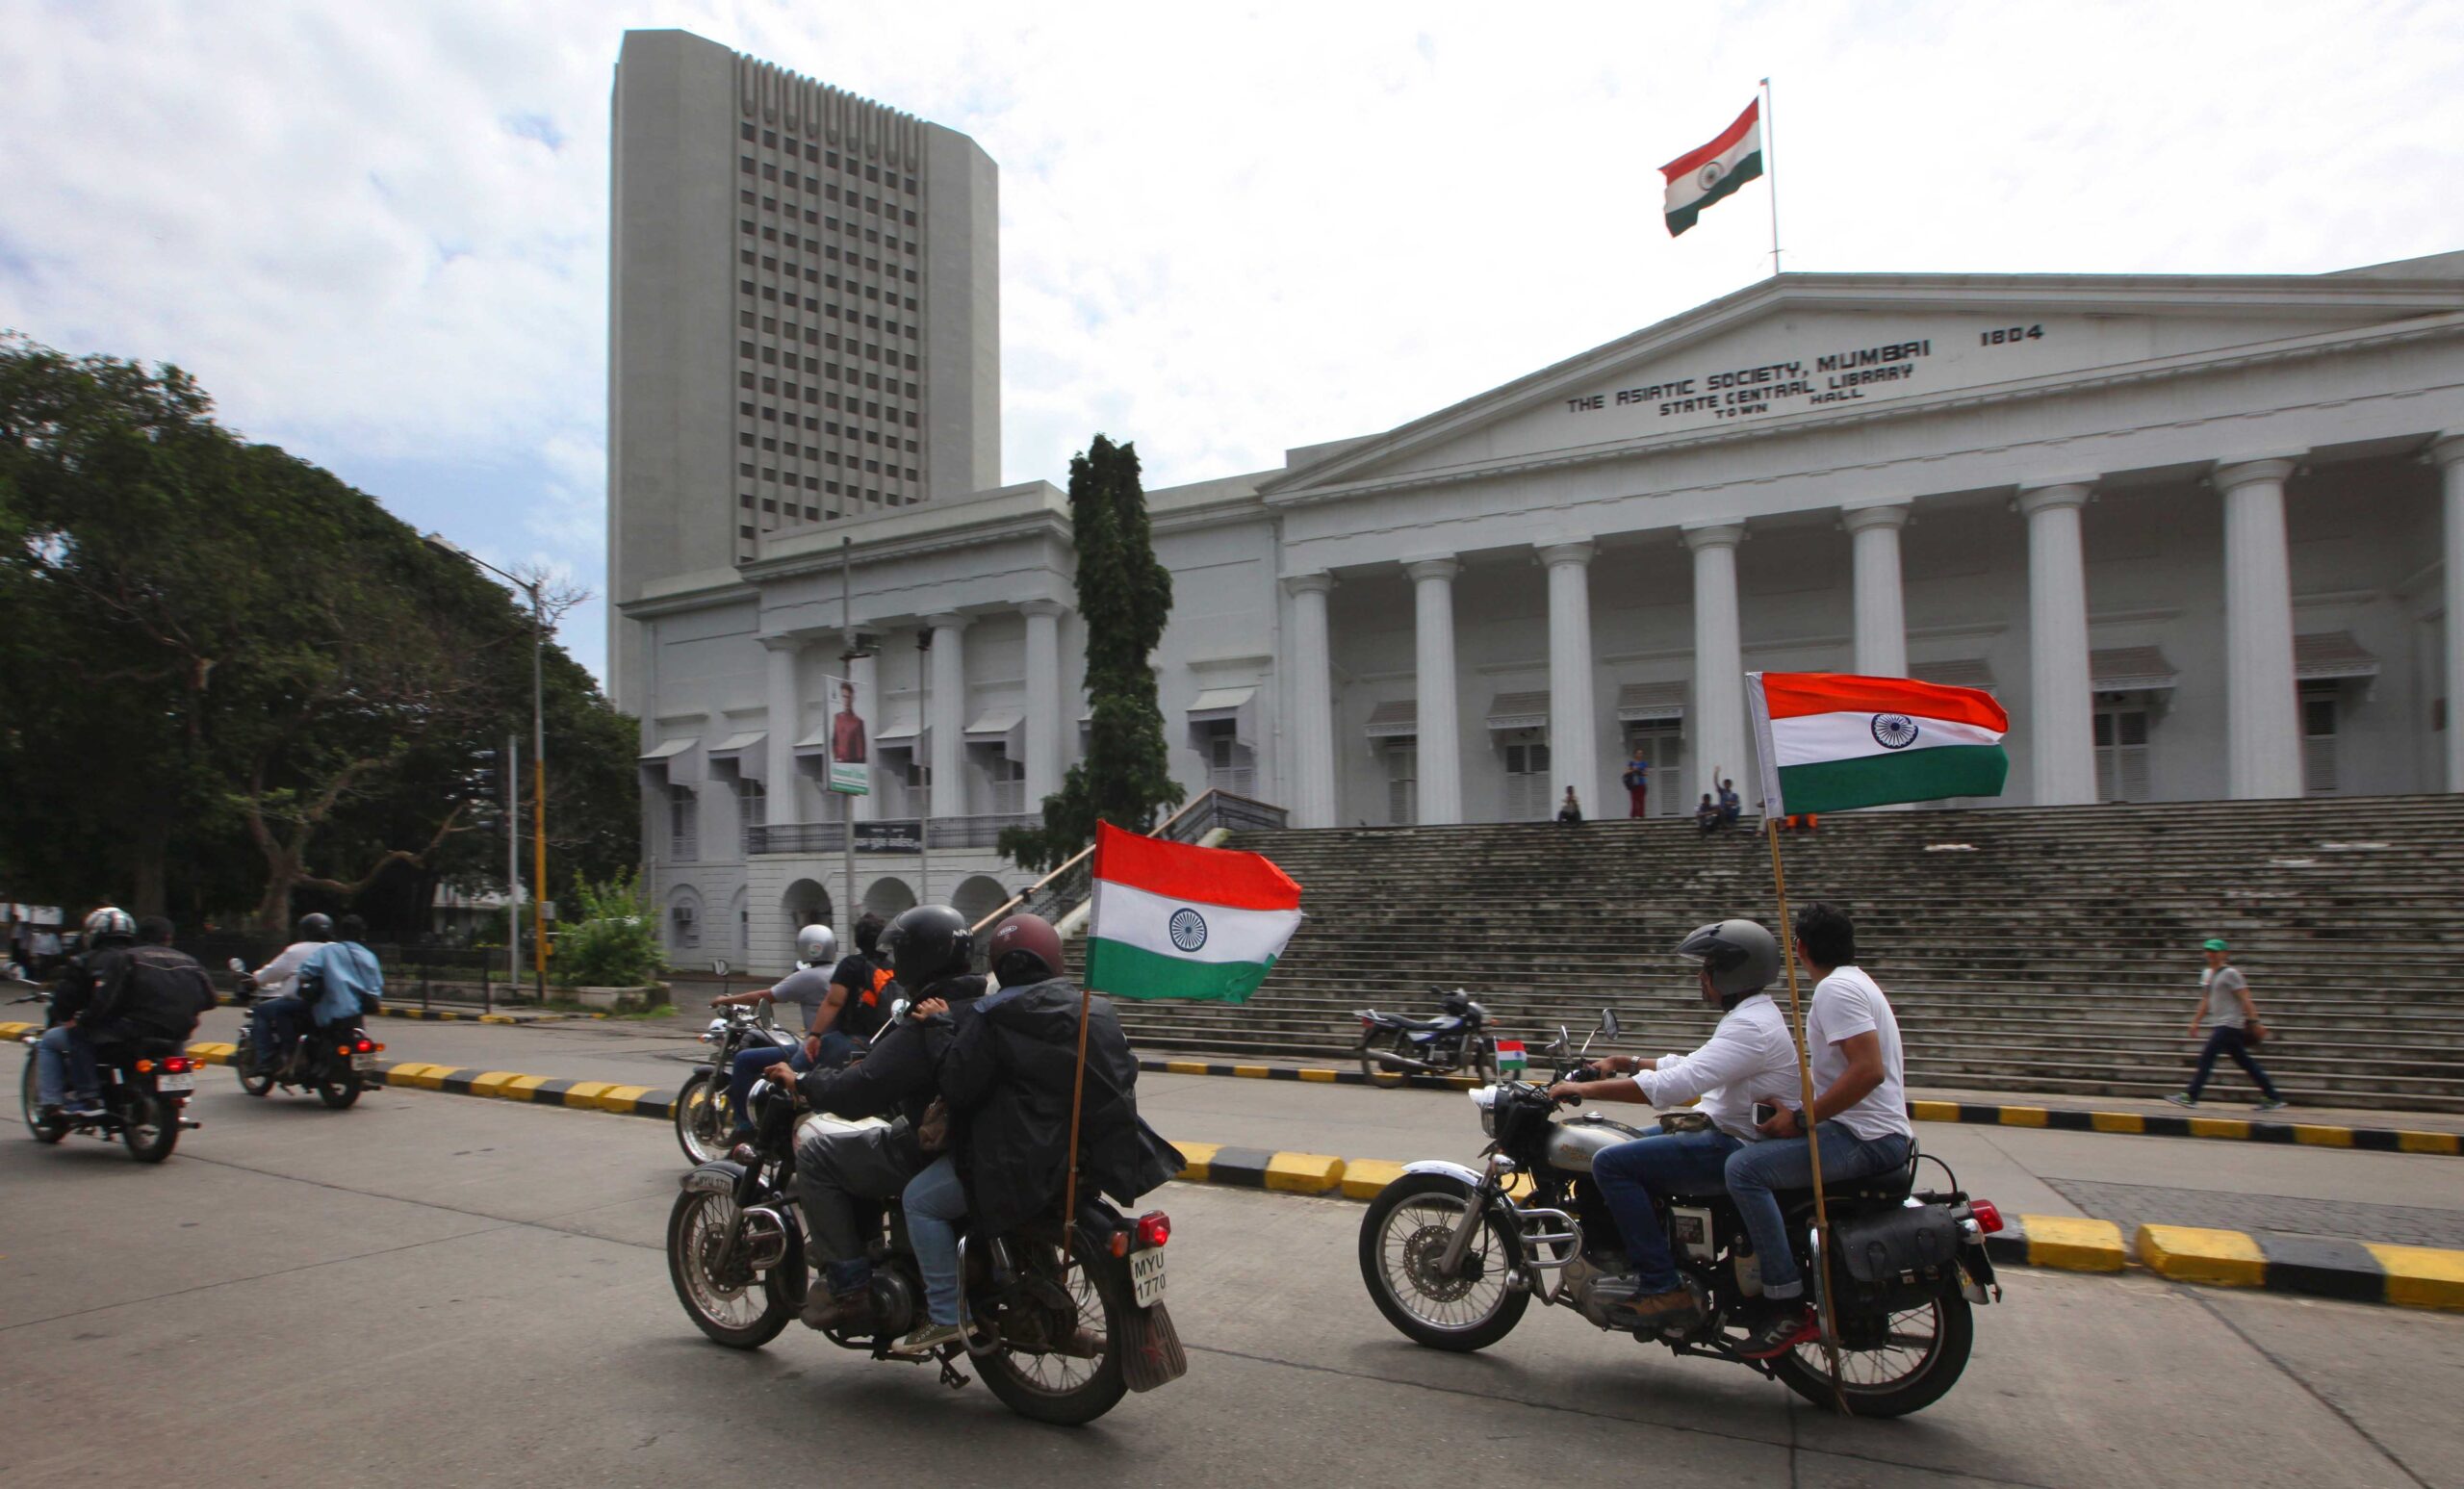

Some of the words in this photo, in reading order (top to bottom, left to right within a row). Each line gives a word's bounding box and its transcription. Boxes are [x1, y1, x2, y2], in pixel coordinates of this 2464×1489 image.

[1981, 323, 2044, 347] 1804
[1567, 395, 1604, 413] THE
[1616, 379, 1695, 406] ASIATIC
[1707, 361, 1810, 391] SOCIETY,
[1817, 339, 1931, 373] MUMBAI
[1659, 395, 1718, 416] STATE
[1726, 380, 1815, 404] CENTRAL
[1829, 363, 1913, 390] LIBRARY
[1714, 402, 1768, 420] TOWN
[1810, 388, 1864, 405] HALL
[1134, 1251, 1164, 1279] MYU
[1137, 1272, 1166, 1300] 1770
